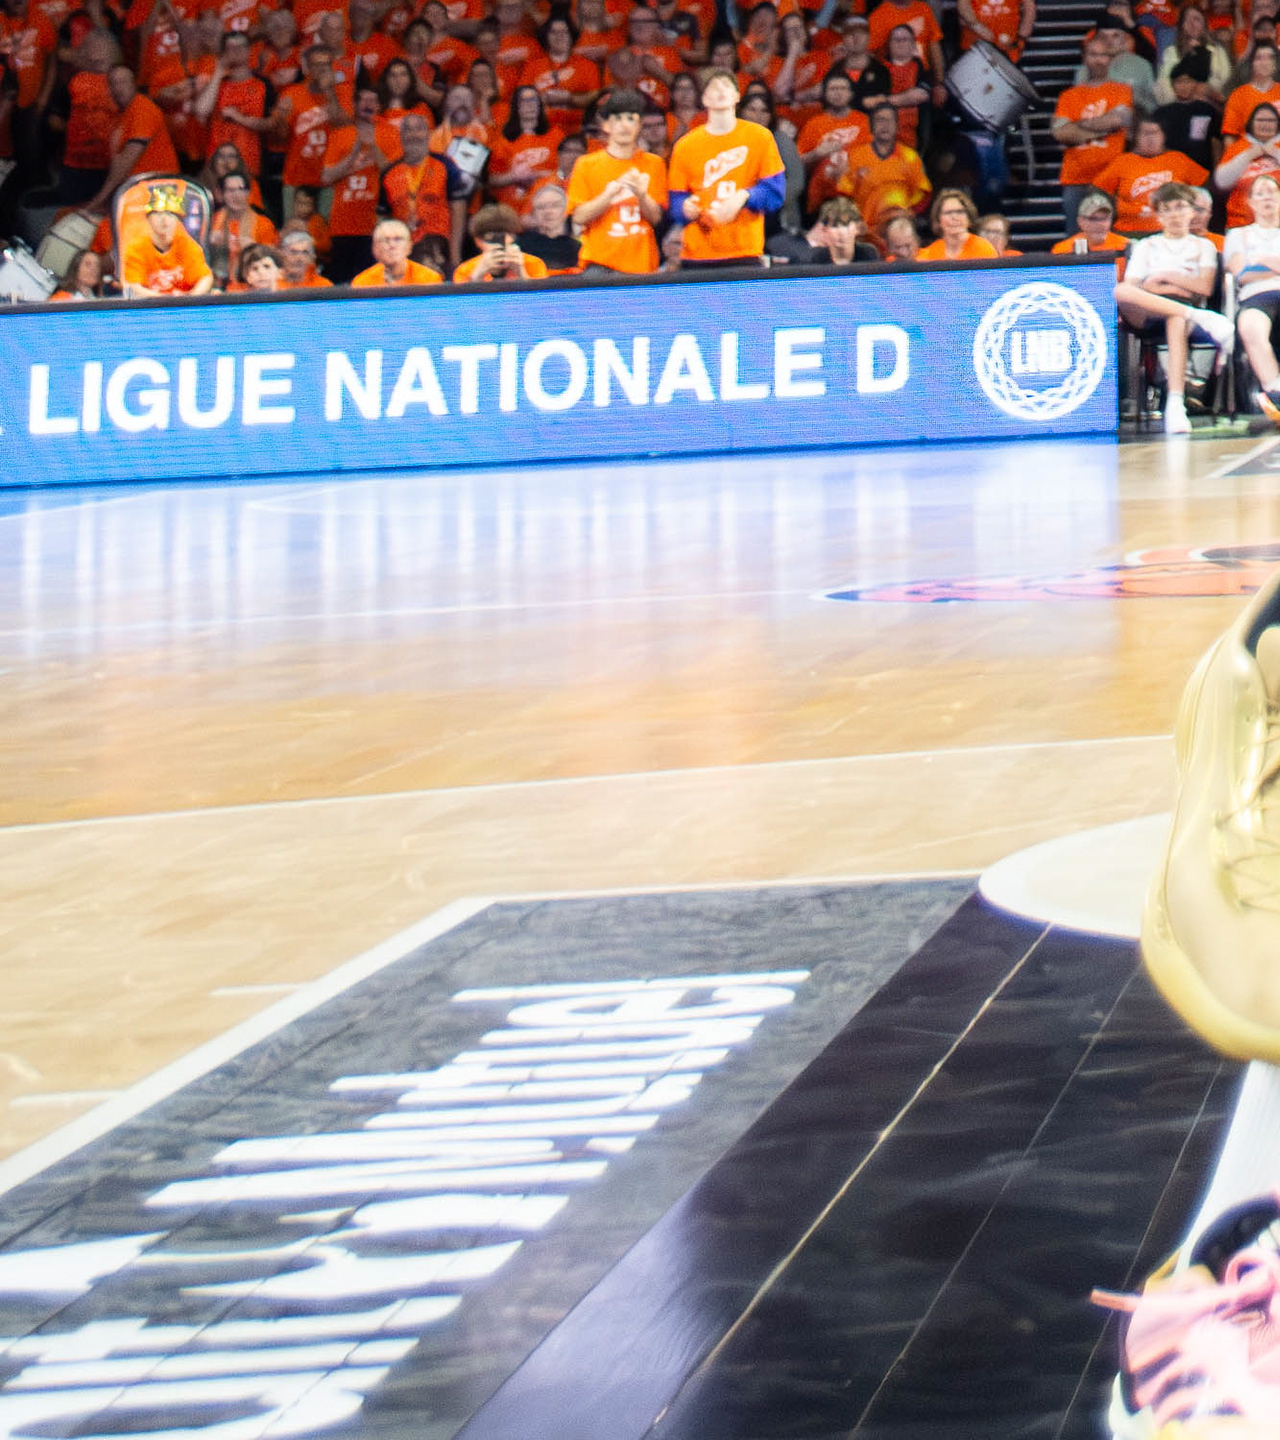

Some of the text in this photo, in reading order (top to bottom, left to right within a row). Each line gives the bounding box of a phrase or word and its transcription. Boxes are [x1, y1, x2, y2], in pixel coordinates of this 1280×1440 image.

[28, 324, 909, 435] LIGUE NATIONALE D
